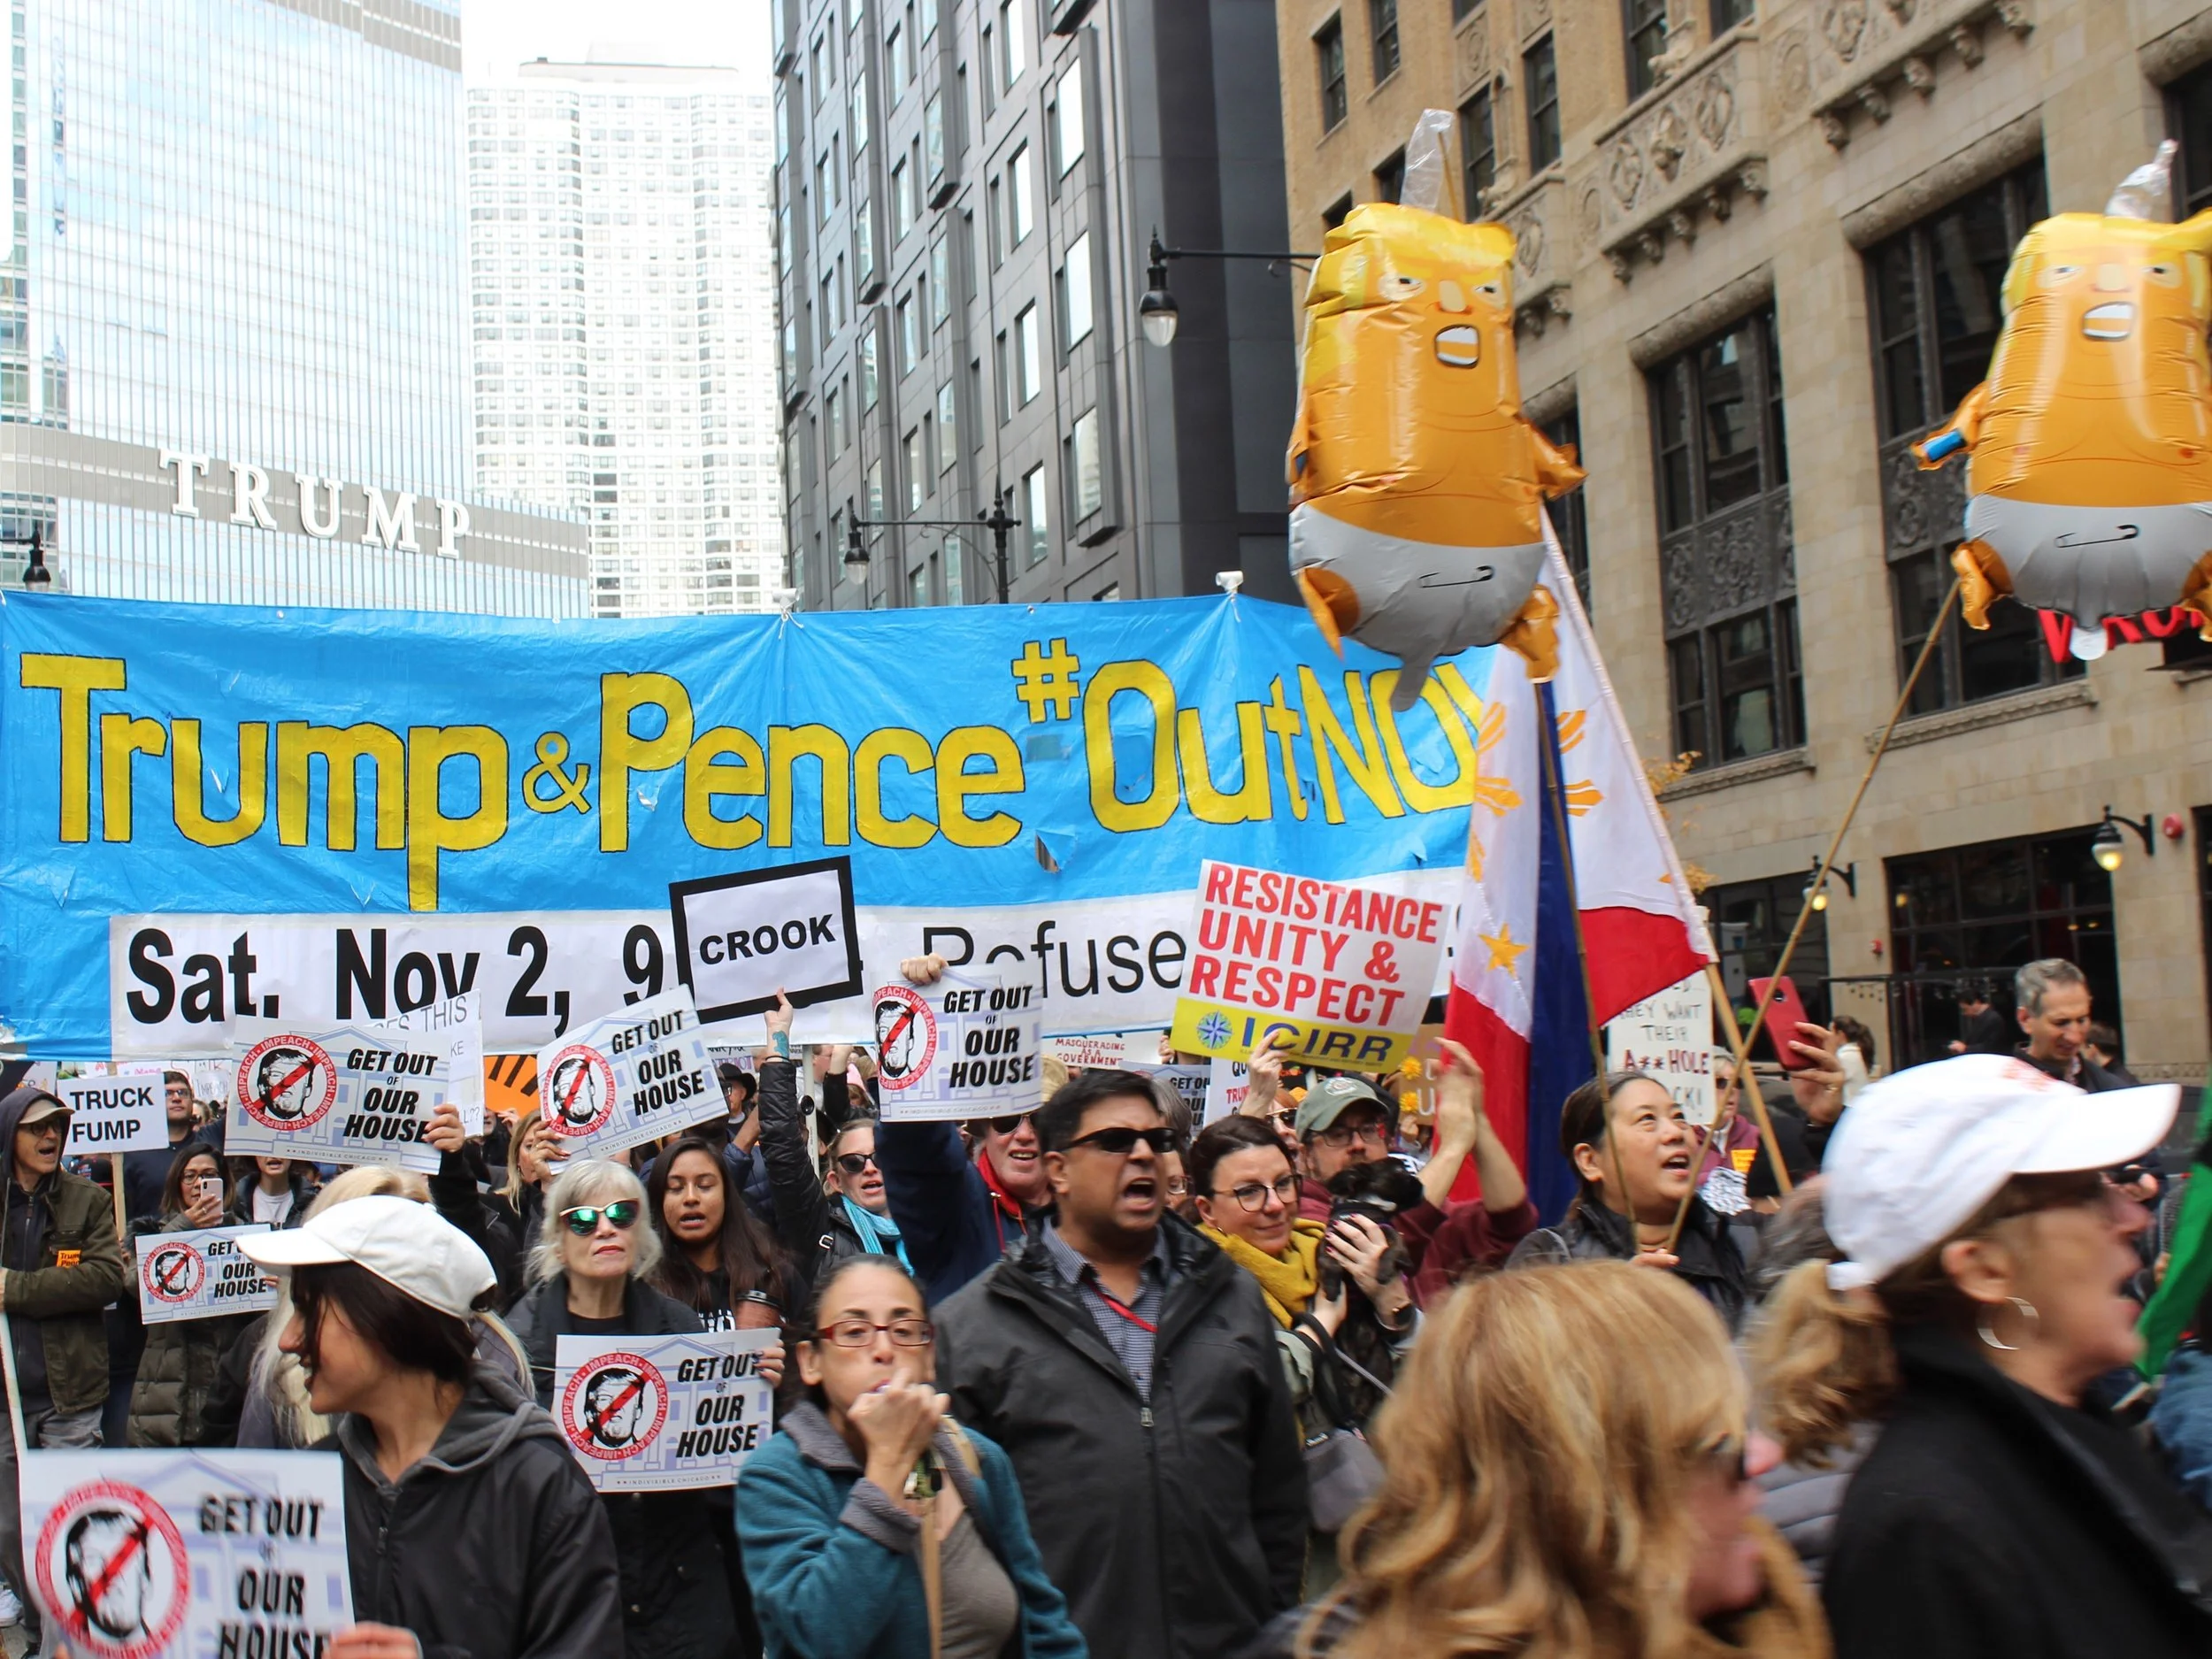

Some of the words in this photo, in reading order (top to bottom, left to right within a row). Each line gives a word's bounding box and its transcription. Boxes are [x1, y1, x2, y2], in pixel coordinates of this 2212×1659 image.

[159, 448, 470, 559] TRUMP
[1205, 863, 1443, 943] RESISTANCE
[700, 914, 835, 964] CROOK
[1198, 909, 1349, 972] UNITY
[1364, 941, 1401, 983] &
[127, 926, 280, 1025] Sat.
[336, 928, 480, 1018] Nov
[505, 926, 570, 1038] 2,
[1188, 954, 1405, 1026] RESPECT
[420, 995, 467, 1033] THIS
[943, 989, 986, 1014] GET
[989, 985, 1033, 1011] OUT
[1620, 1001, 1656, 1019] HEY
[611, 1025, 644, 1055] GET
[649, 1010, 683, 1041] OUT
[910, 995, 936, 1041] IMPEACH
[986, 1014, 997, 1025] OF
[1640, 1025, 1688, 1041] THEIR
[260, 1036, 311, 1051] IMPEACH
[964, 1026, 1020, 1056] OUR
[1055, 1038, 1125, 1050] MASQUERADING
[1241, 1017, 1393, 1062] ICIRR
[238, 1052, 257, 1101] IMPEACH
[313, 1046, 336, 1093] IMPEACH
[347, 1048, 391, 1072] GET
[393, 1053, 439, 1076] OUT
[638, 1049, 682, 1085] OUR
[949, 1054, 1034, 1088] HOUSE
[387, 1076, 400, 1086] OF
[633, 1070, 705, 1117] HOUSE
[1194, 1077, 1210, 1089] OU
[1226, 1086, 1250, 1104] TRUM
[70, 1087, 154, 1110] TRUCK
[364, 1087, 419, 1115] OUR
[73, 1120, 141, 1142] FUMP
[461, 1107, 480, 1125] L??
[549, 1121, 592, 1136] IMPEACH
[208, 1240, 234, 1256] GET
[223, 1263, 256, 1279] OUR
[214, 1279, 267, 1298] HOUSE
[586, 1354, 640, 1371] IMPEACH
[678, 1357, 718, 1382] GET
[563, 1373, 583, 1428] IMPEACH
[642, 1363, 667, 1410] IMPEACH
[716, 1382, 727, 1394] OF
[695, 1394, 745, 1425] OUR
[676, 1425, 758, 1458] HOUSE
[200, 1494, 257, 1533] GET
[265, 1495, 325, 1538] OUT
[238, 1567, 305, 1616] OUR
